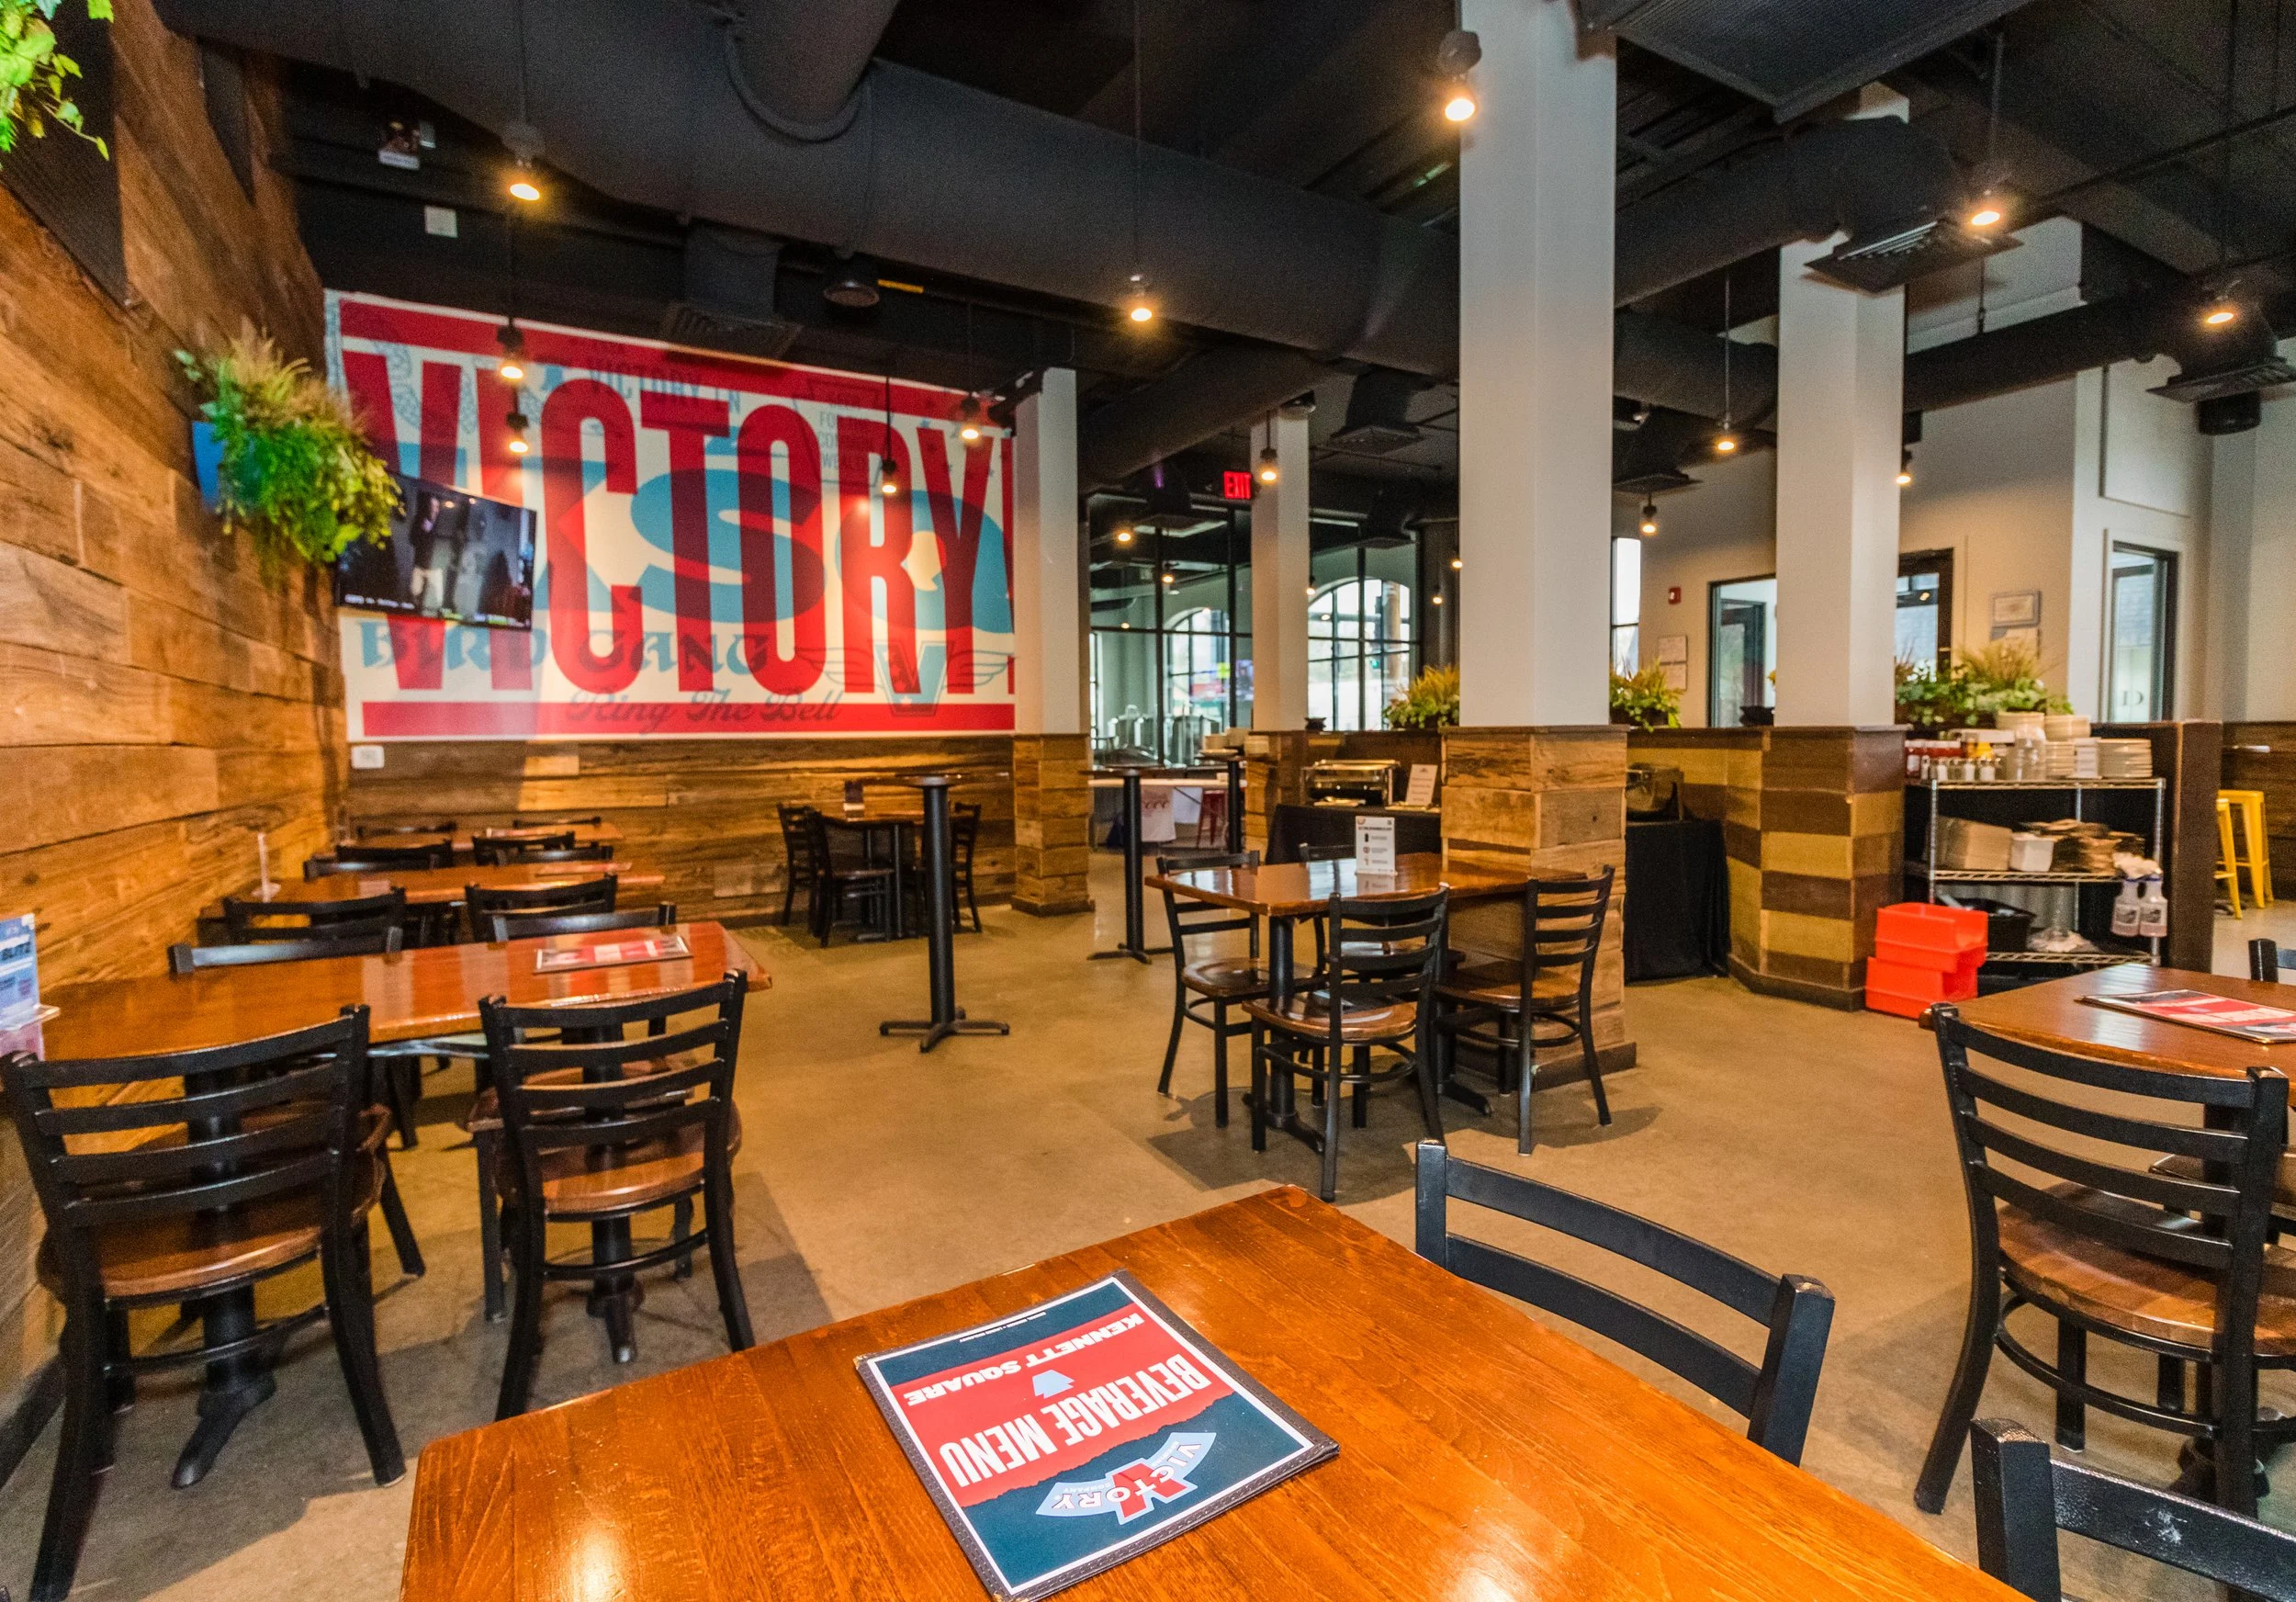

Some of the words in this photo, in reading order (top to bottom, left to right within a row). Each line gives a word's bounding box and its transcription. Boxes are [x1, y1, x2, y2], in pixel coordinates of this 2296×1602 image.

[1223, 470, 1252, 500] EXIT
[566, 686, 674, 736] Ring
[686, 685, 752, 723] The
[760, 685, 844, 724] Bell
[1026, 1313, 1145, 1369] KENNETT
[904, 1359, 1024, 1407] SQUARE
[1040, 1353, 1212, 1447] BEVERAGE
[939, 1414, 1058, 1488] MENU
[1051, 1443, 1202, 1510] VICTORY
